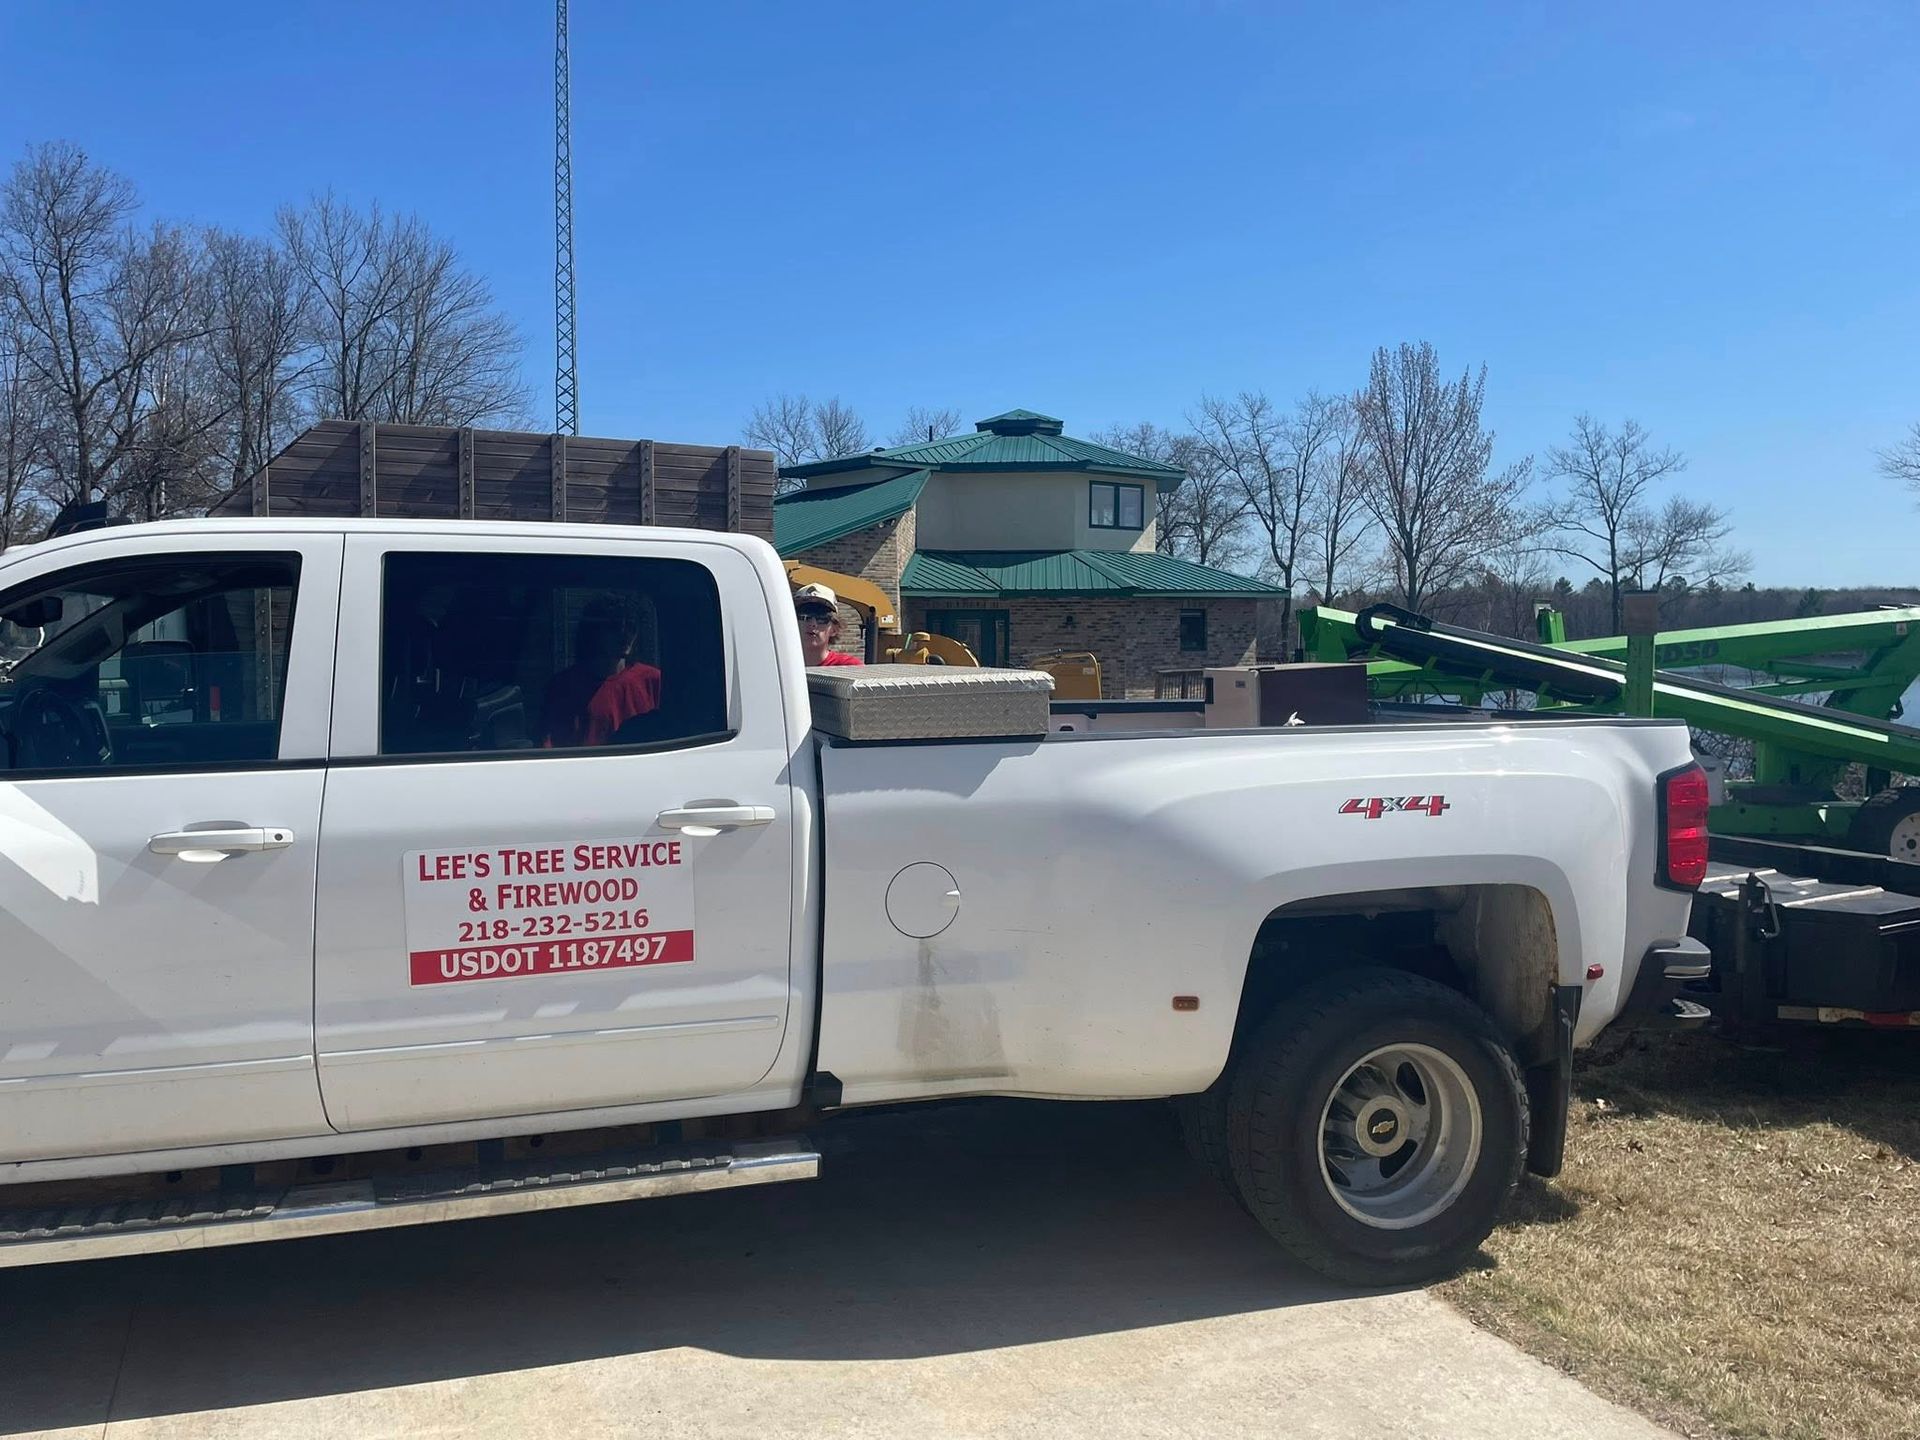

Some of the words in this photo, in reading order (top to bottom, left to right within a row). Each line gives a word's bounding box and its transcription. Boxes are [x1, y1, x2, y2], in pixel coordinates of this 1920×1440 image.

[419, 854, 490, 881] LEE'S
[498, 849, 565, 876] TREE
[573, 842, 681, 871] SERVICE
[468, 888, 488, 912] &
[498, 878, 639, 910] FIREWOOD
[458, 909, 650, 942] 218-232-5216
[440, 947, 540, 978] USDOT
[549, 936, 667, 968] 1187497
